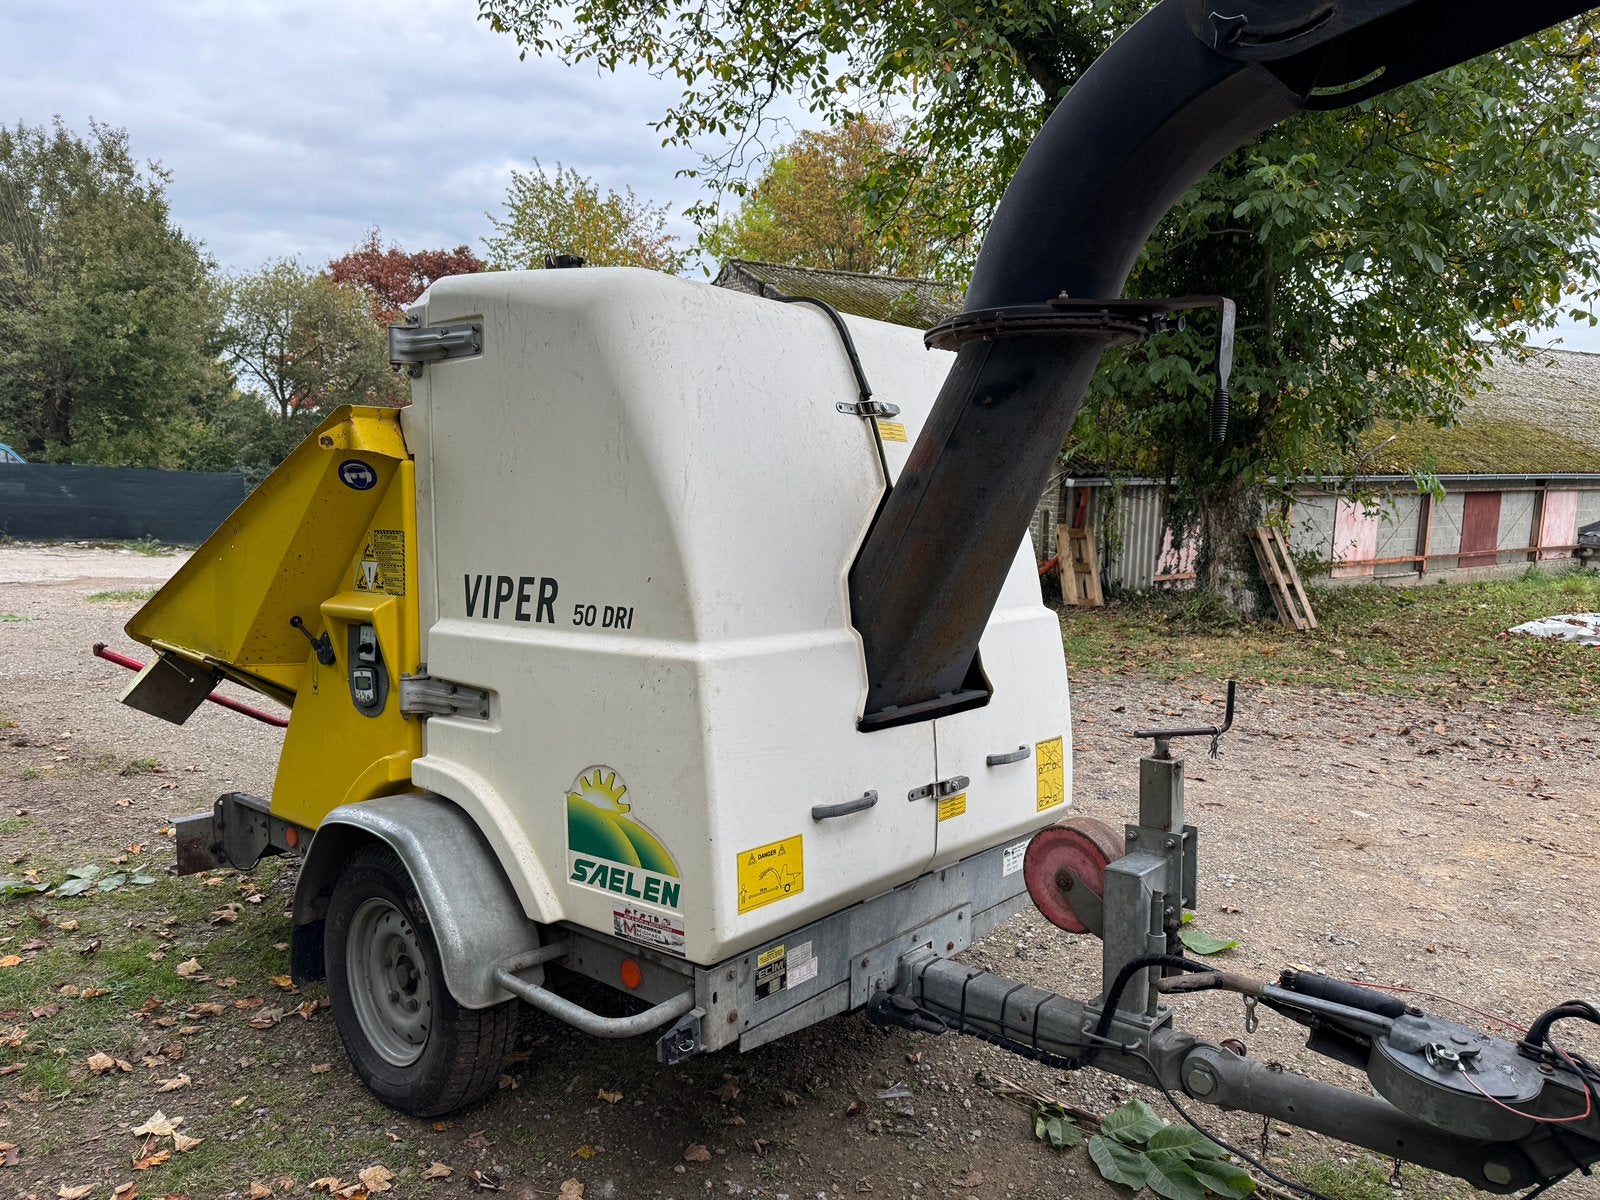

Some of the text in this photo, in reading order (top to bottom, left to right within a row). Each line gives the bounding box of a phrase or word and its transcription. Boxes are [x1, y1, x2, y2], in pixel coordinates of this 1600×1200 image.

[464, 574, 634, 630] VIPER 50 DRI
[757, 848, 777, 860] DANGER
[570, 858, 681, 909] SAELEN
